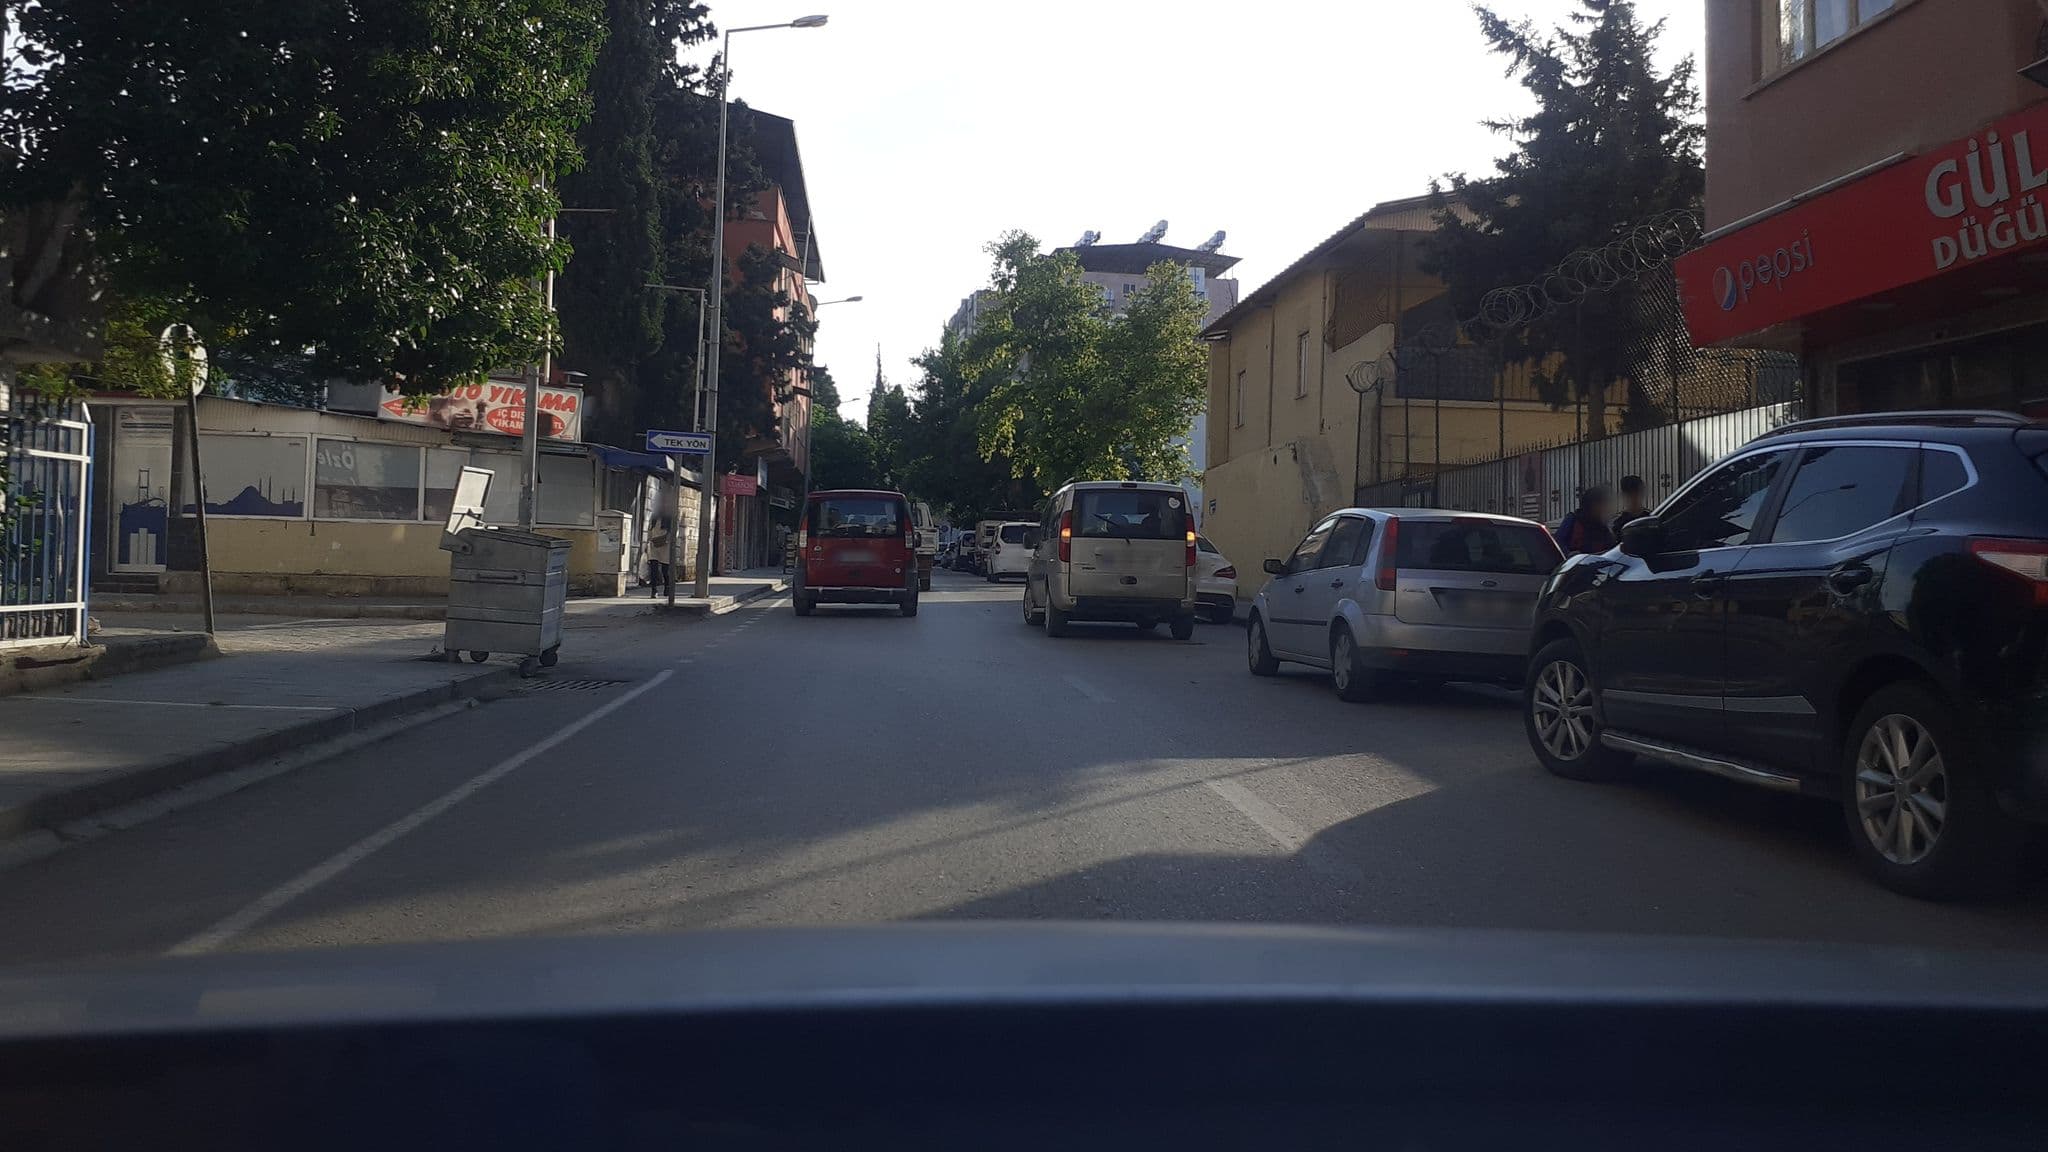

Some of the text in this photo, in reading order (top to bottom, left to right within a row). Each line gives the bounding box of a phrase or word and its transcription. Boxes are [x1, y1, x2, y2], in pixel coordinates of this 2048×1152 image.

[1925, 130, 2048, 217] GÜL
[1740, 228, 1813, 302] pepsi
[489, 385, 577, 413] YIKMA
[664, 438, 706, 448] TEK YÖN
